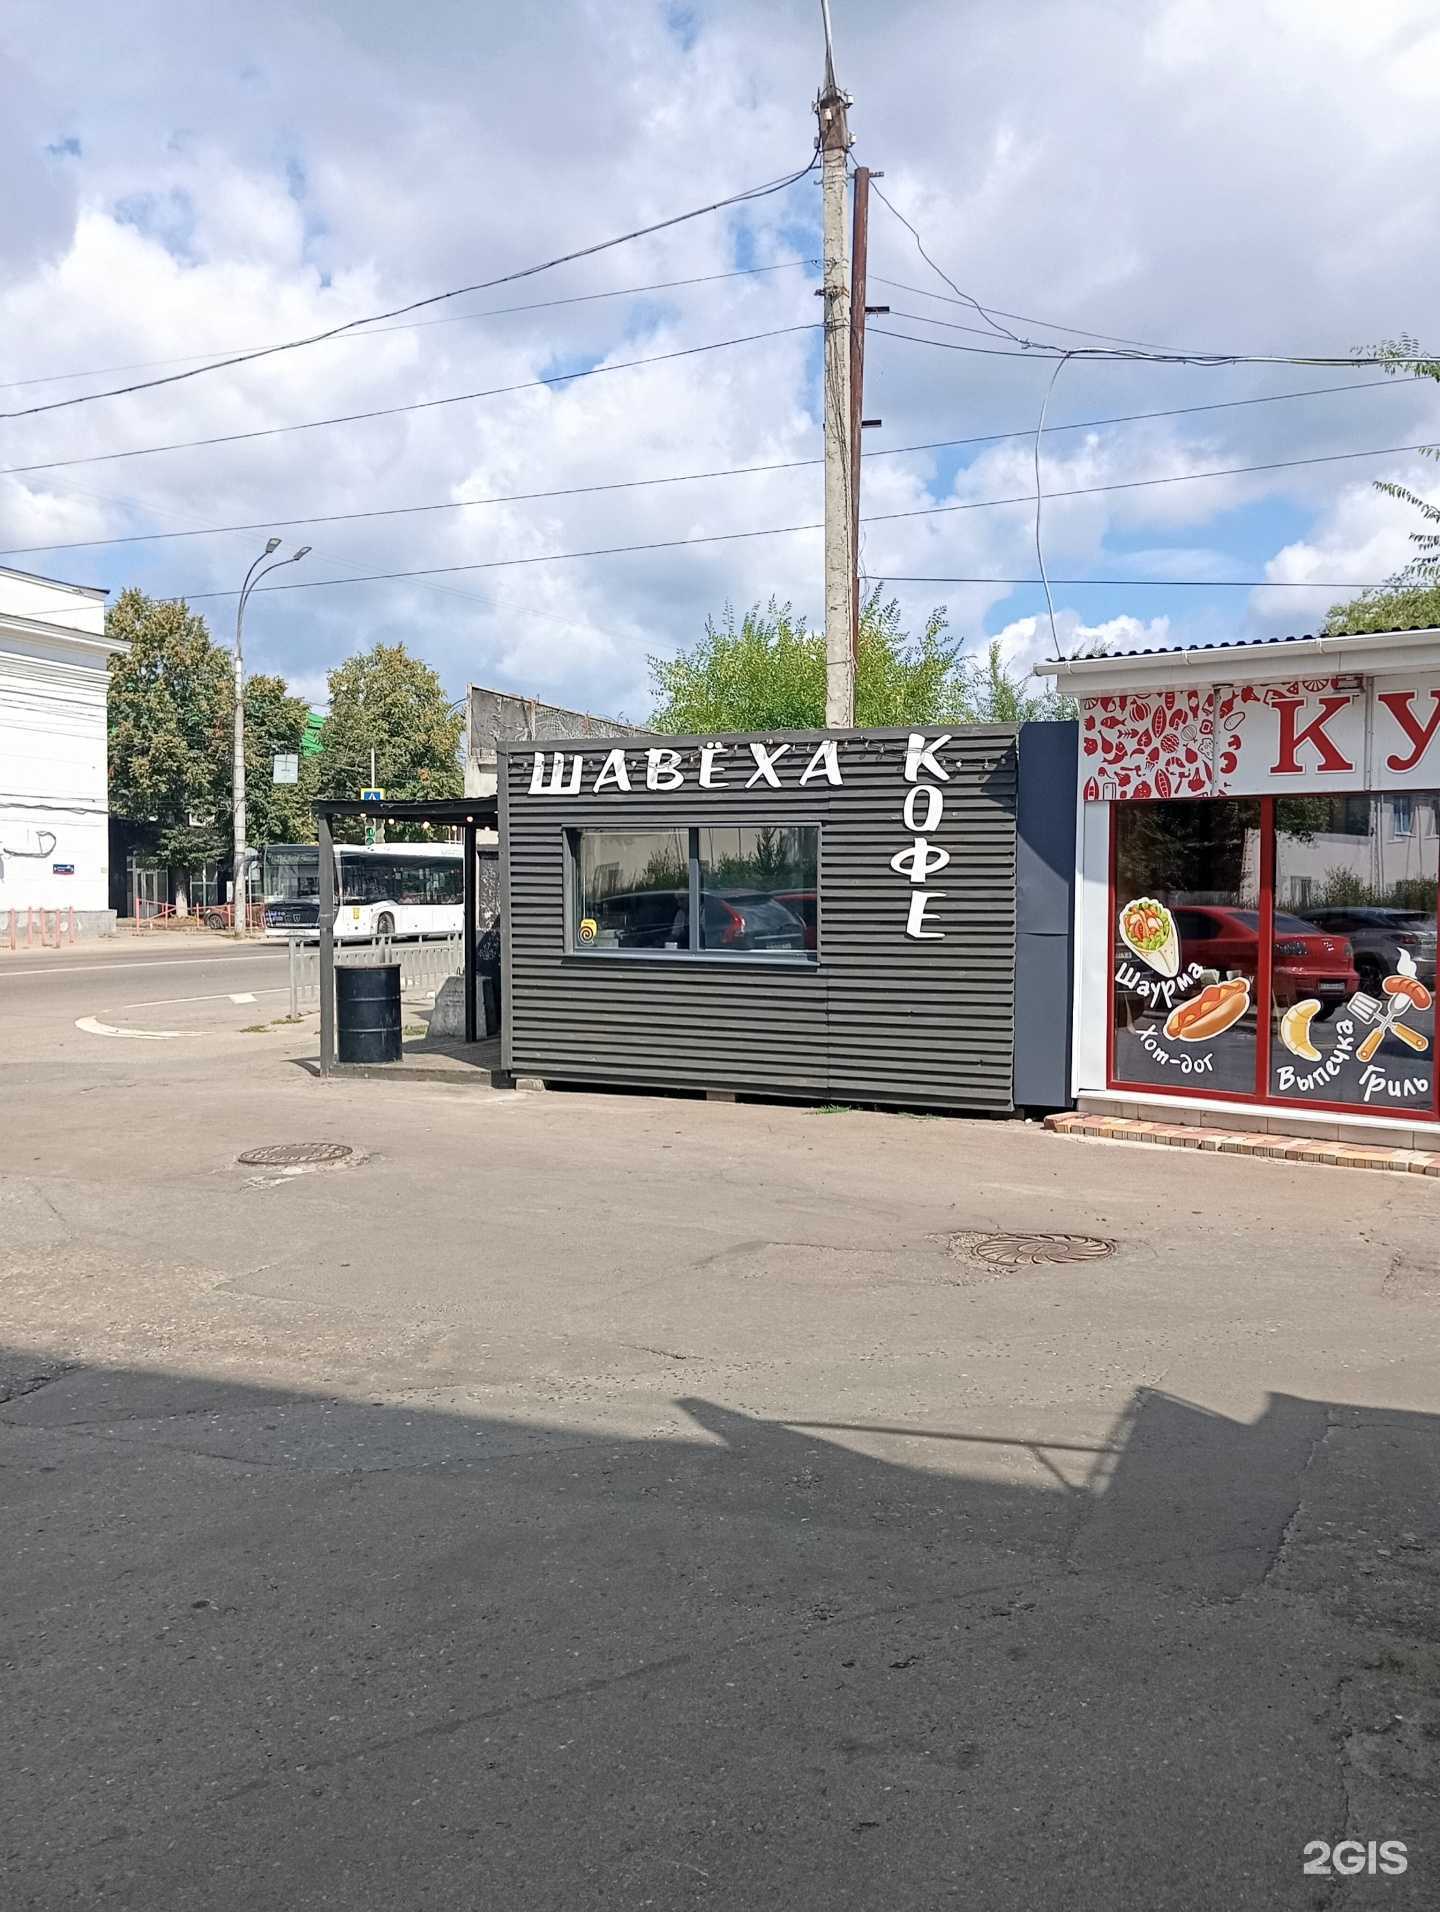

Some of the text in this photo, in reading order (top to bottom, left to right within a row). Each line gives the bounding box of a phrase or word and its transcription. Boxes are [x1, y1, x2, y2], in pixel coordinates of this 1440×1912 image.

[528, 741, 844, 796] ШАВЁХА
[890, 733, 952, 939] КОФЕ
[1114, 963, 1203, 1009] Шаурма
[1276, 1019, 1354, 1092] Выпечка
[1358, 1064, 1429, 1102] Гриль
